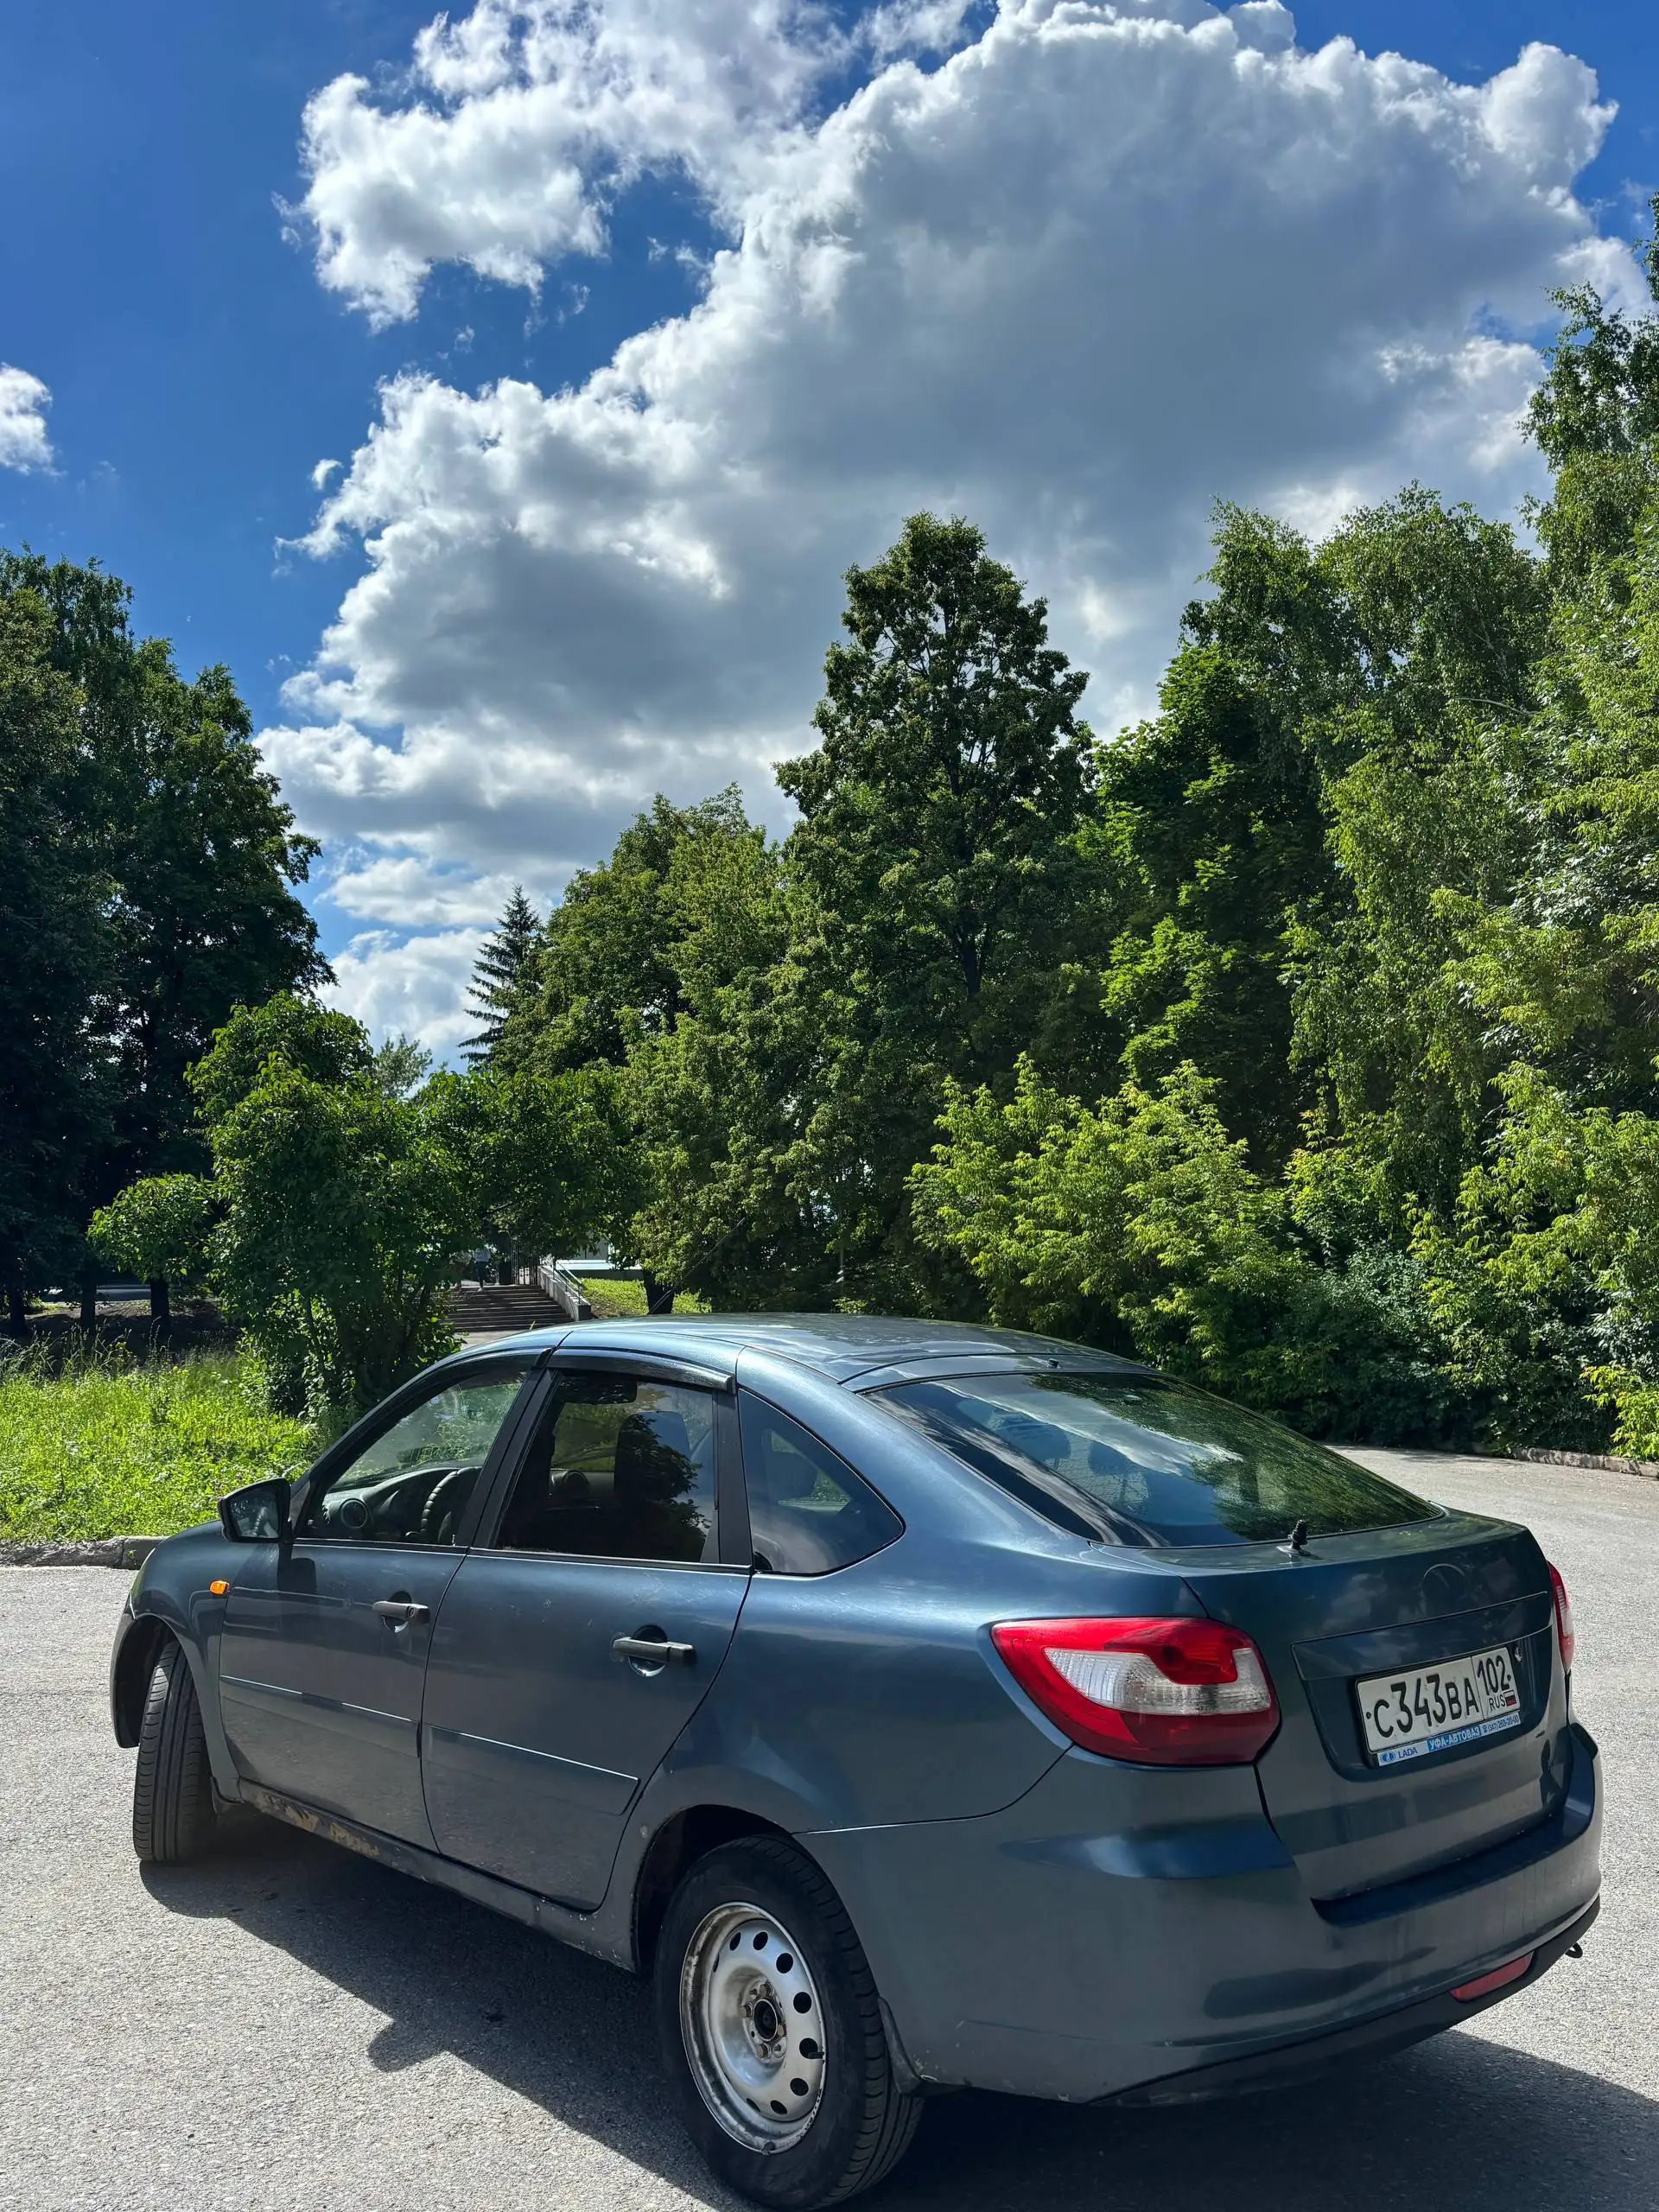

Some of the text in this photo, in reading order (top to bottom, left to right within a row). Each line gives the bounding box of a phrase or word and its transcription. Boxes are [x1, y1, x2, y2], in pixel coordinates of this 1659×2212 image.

[1374, 1656, 1510, 1738] С343ВА 102
[1489, 1694, 1505, 1711] RUS
[1398, 1746, 1418, 1758] LADA
